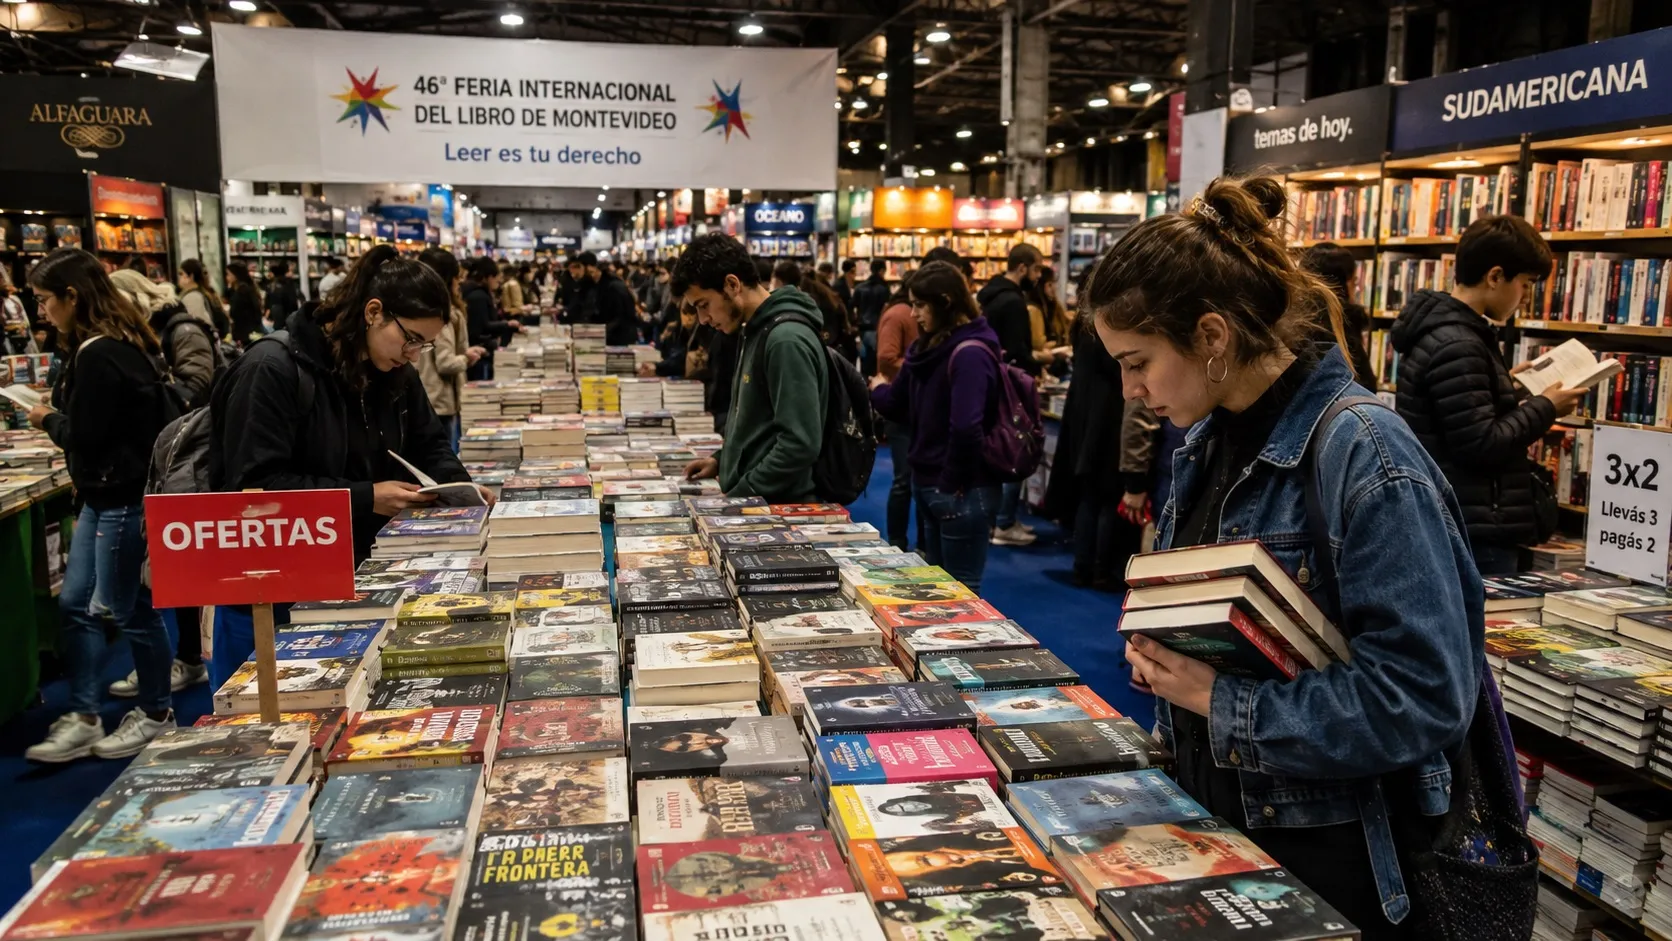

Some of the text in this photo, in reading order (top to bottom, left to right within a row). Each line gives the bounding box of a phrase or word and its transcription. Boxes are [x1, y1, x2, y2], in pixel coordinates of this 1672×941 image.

[413, 76, 676, 102] 46ª FERIA INTERNACIONAL
[1442, 58, 1648, 122] SUDAMERICANA
[29, 103, 152, 126] ALFAGUARA
[414, 105, 677, 130] DEL LIBRO DE MONTEVIDEO
[1254, 114, 1353, 149] temas de hoy.
[445, 142, 641, 165] Leer es tu derecho
[755, 208, 804, 224] OCEANO
[1605, 453, 1659, 491] 3x2
[1601, 501, 1658, 526] Llevás 3
[162, 516, 338, 550] OFERTAS
[1600, 529, 1656, 553] pagás 2
[483, 860, 590, 883] FRONTERA
